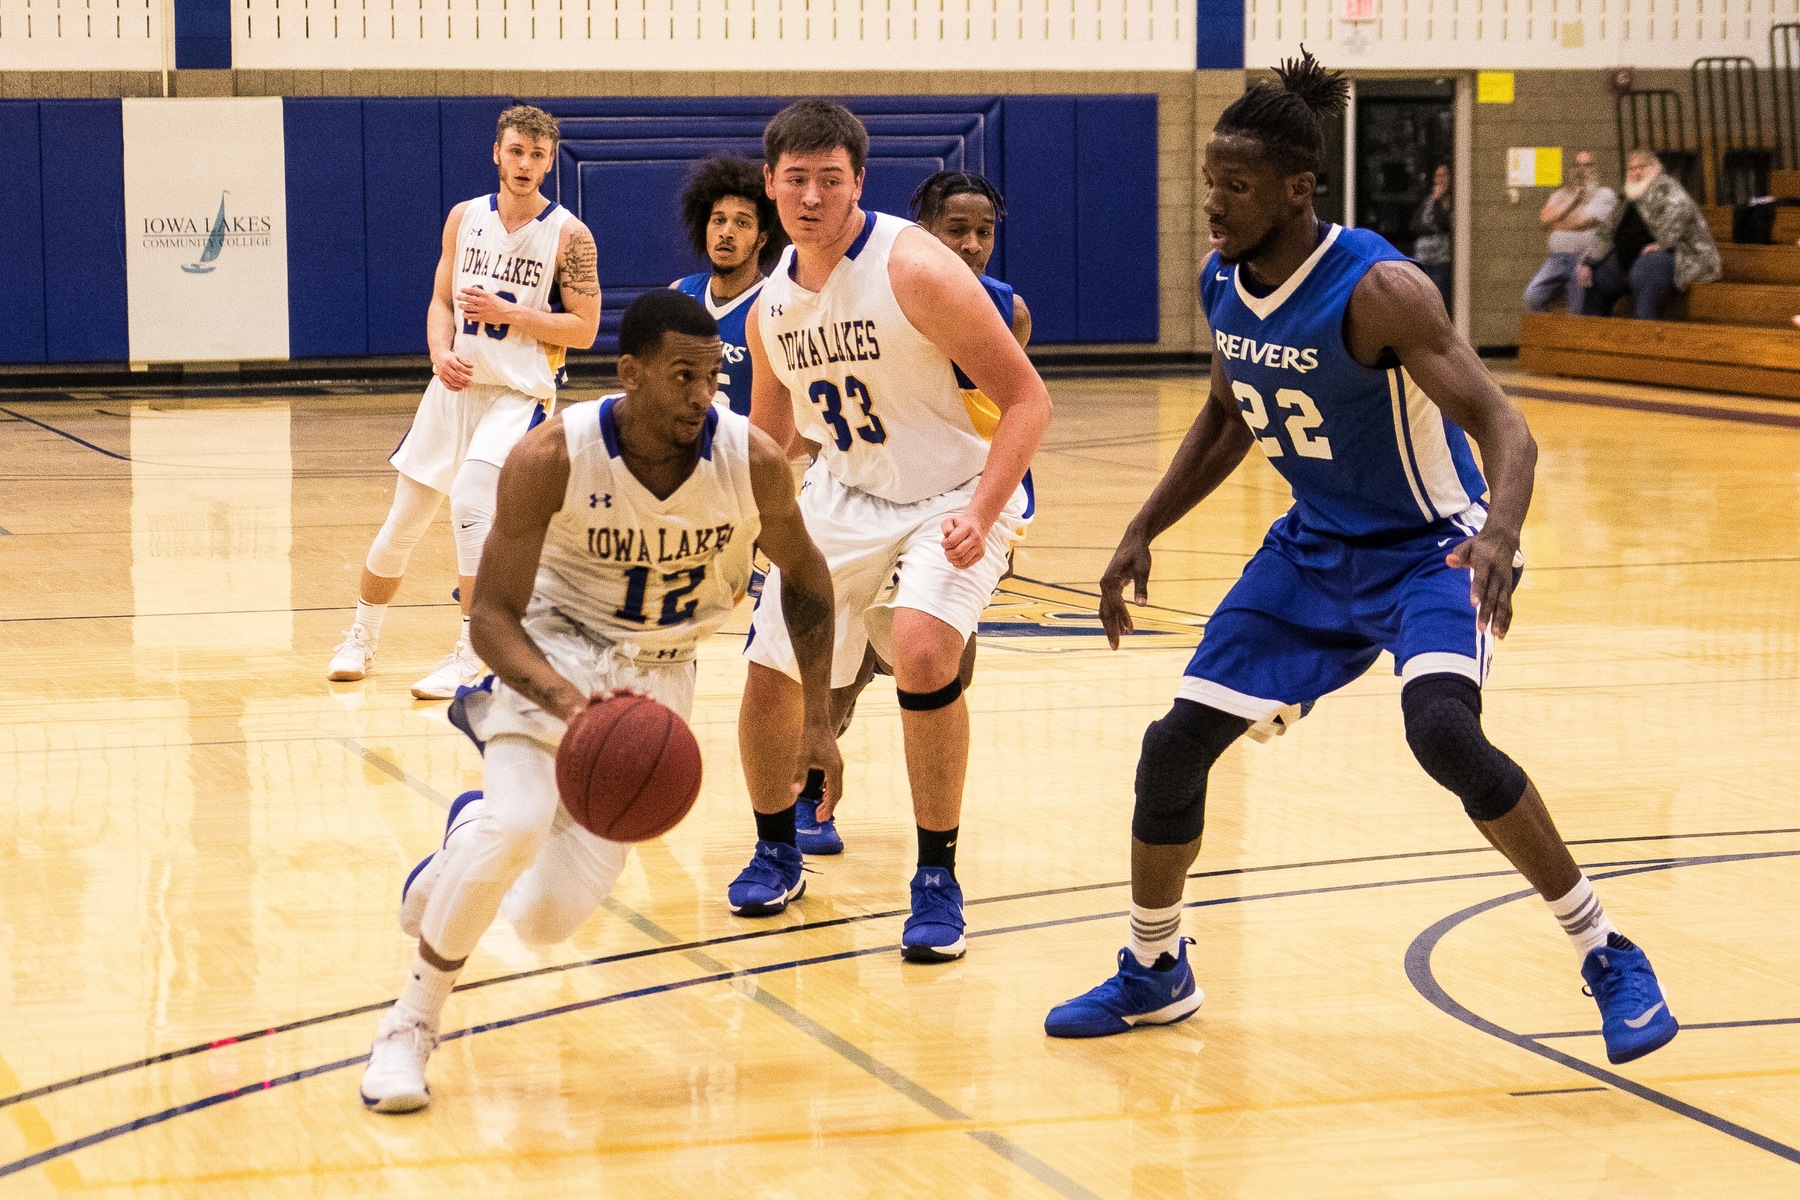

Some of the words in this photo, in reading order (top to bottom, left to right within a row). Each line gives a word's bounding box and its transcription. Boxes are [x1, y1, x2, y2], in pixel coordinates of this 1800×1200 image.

[142, 238, 215, 249] COMMUNITY
[218, 236, 272, 248] COLLEGE
[143, 217, 198, 234] IOWA
[204, 215, 271, 233] LAKES
[461, 247, 489, 276] IOWA
[491, 250, 543, 288] LAKES
[777, 328, 823, 371] IOWA
[818, 320, 881, 364] LAKES
[1215, 328, 1319, 374] REIVERS
[808, 374, 889, 452] 33
[1231, 379, 1334, 461] 22
[587, 527, 651, 562] IOWA
[614, 564, 707, 627] 12
